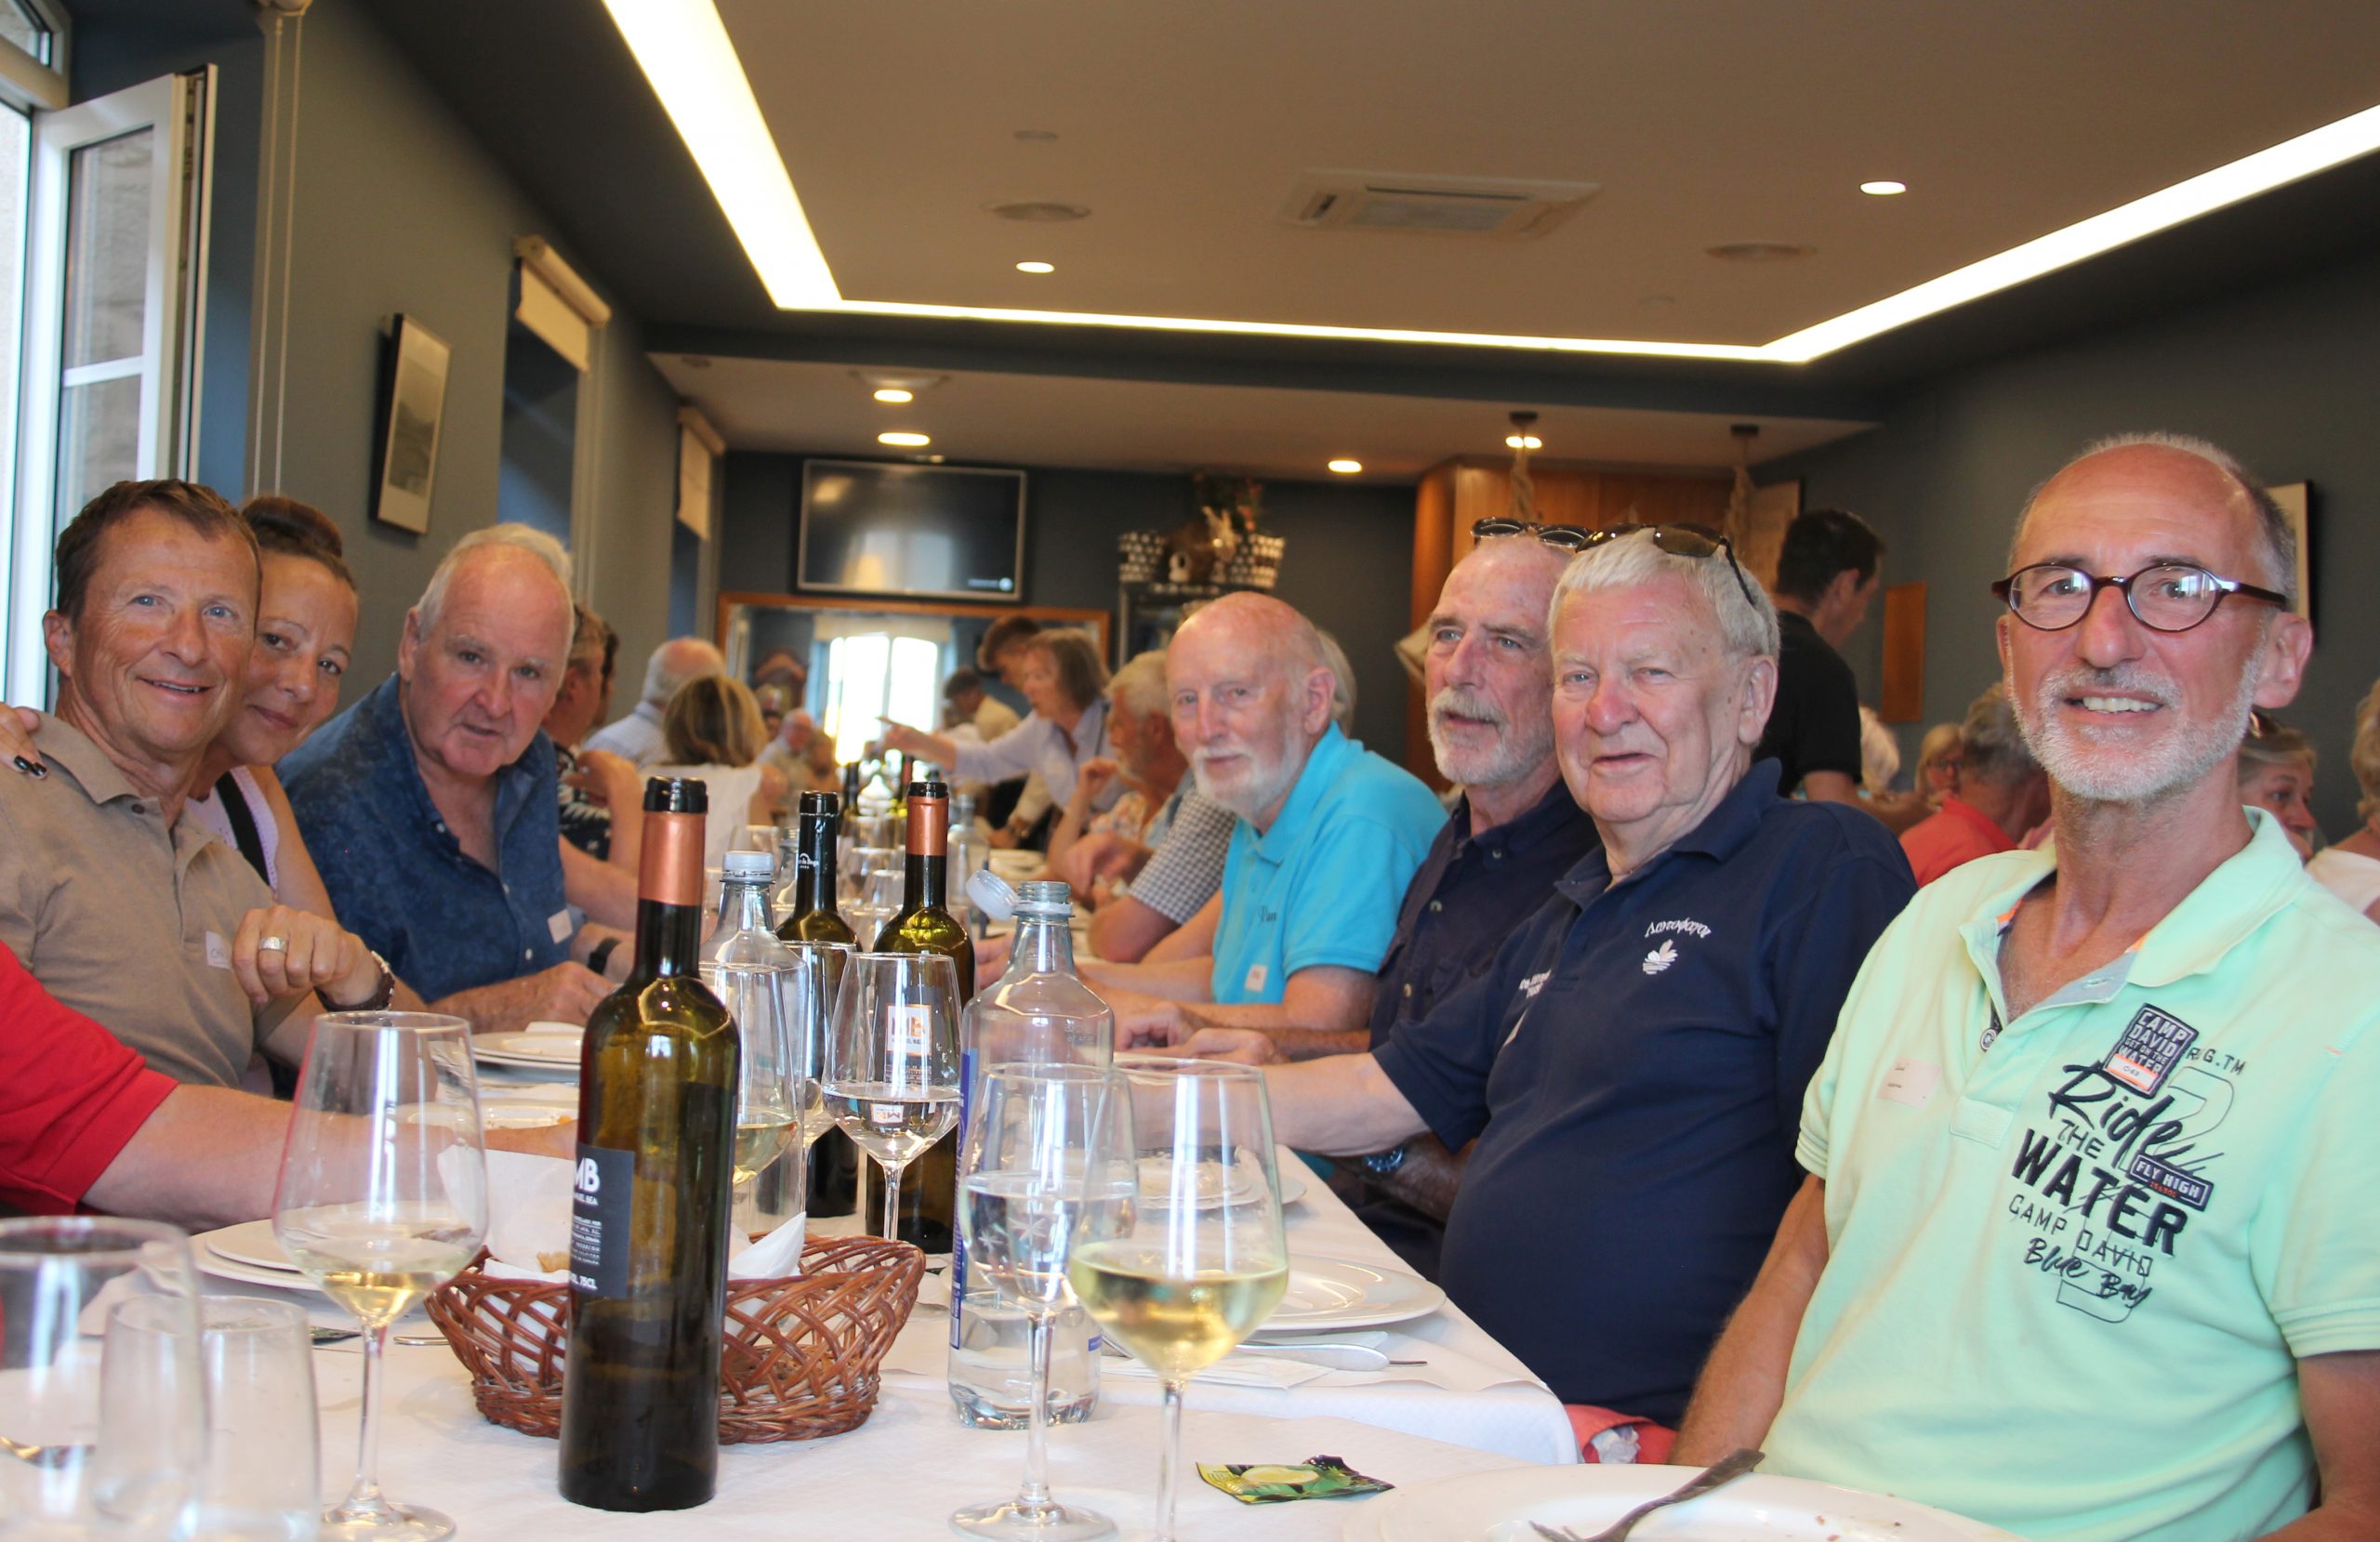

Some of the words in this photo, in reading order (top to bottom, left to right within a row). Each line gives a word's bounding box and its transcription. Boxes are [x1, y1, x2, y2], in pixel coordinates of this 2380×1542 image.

[2128, 1022, 2179, 1058] DAVID
[2137, 1011, 2188, 1043] CAMP
[2118, 1045, 2164, 1074] WATER
[2123, 1037, 2141, 1049] GET
[2139, 1044, 2151, 1057] ON
[2151, 1051, 2170, 1066] THE
[2048, 1061, 2196, 1169] Ride
[2056, 1118, 2106, 1160] THE
[2011, 1127, 2188, 1256] WATER
[2135, 1160, 2161, 1180] FLY
[2162, 1173, 2201, 1199] HIGH
[2008, 1193, 2068, 1235] CAMP
[2023, 1237, 2090, 1279] Blue
[2098, 1272, 2153, 1309] Bay
